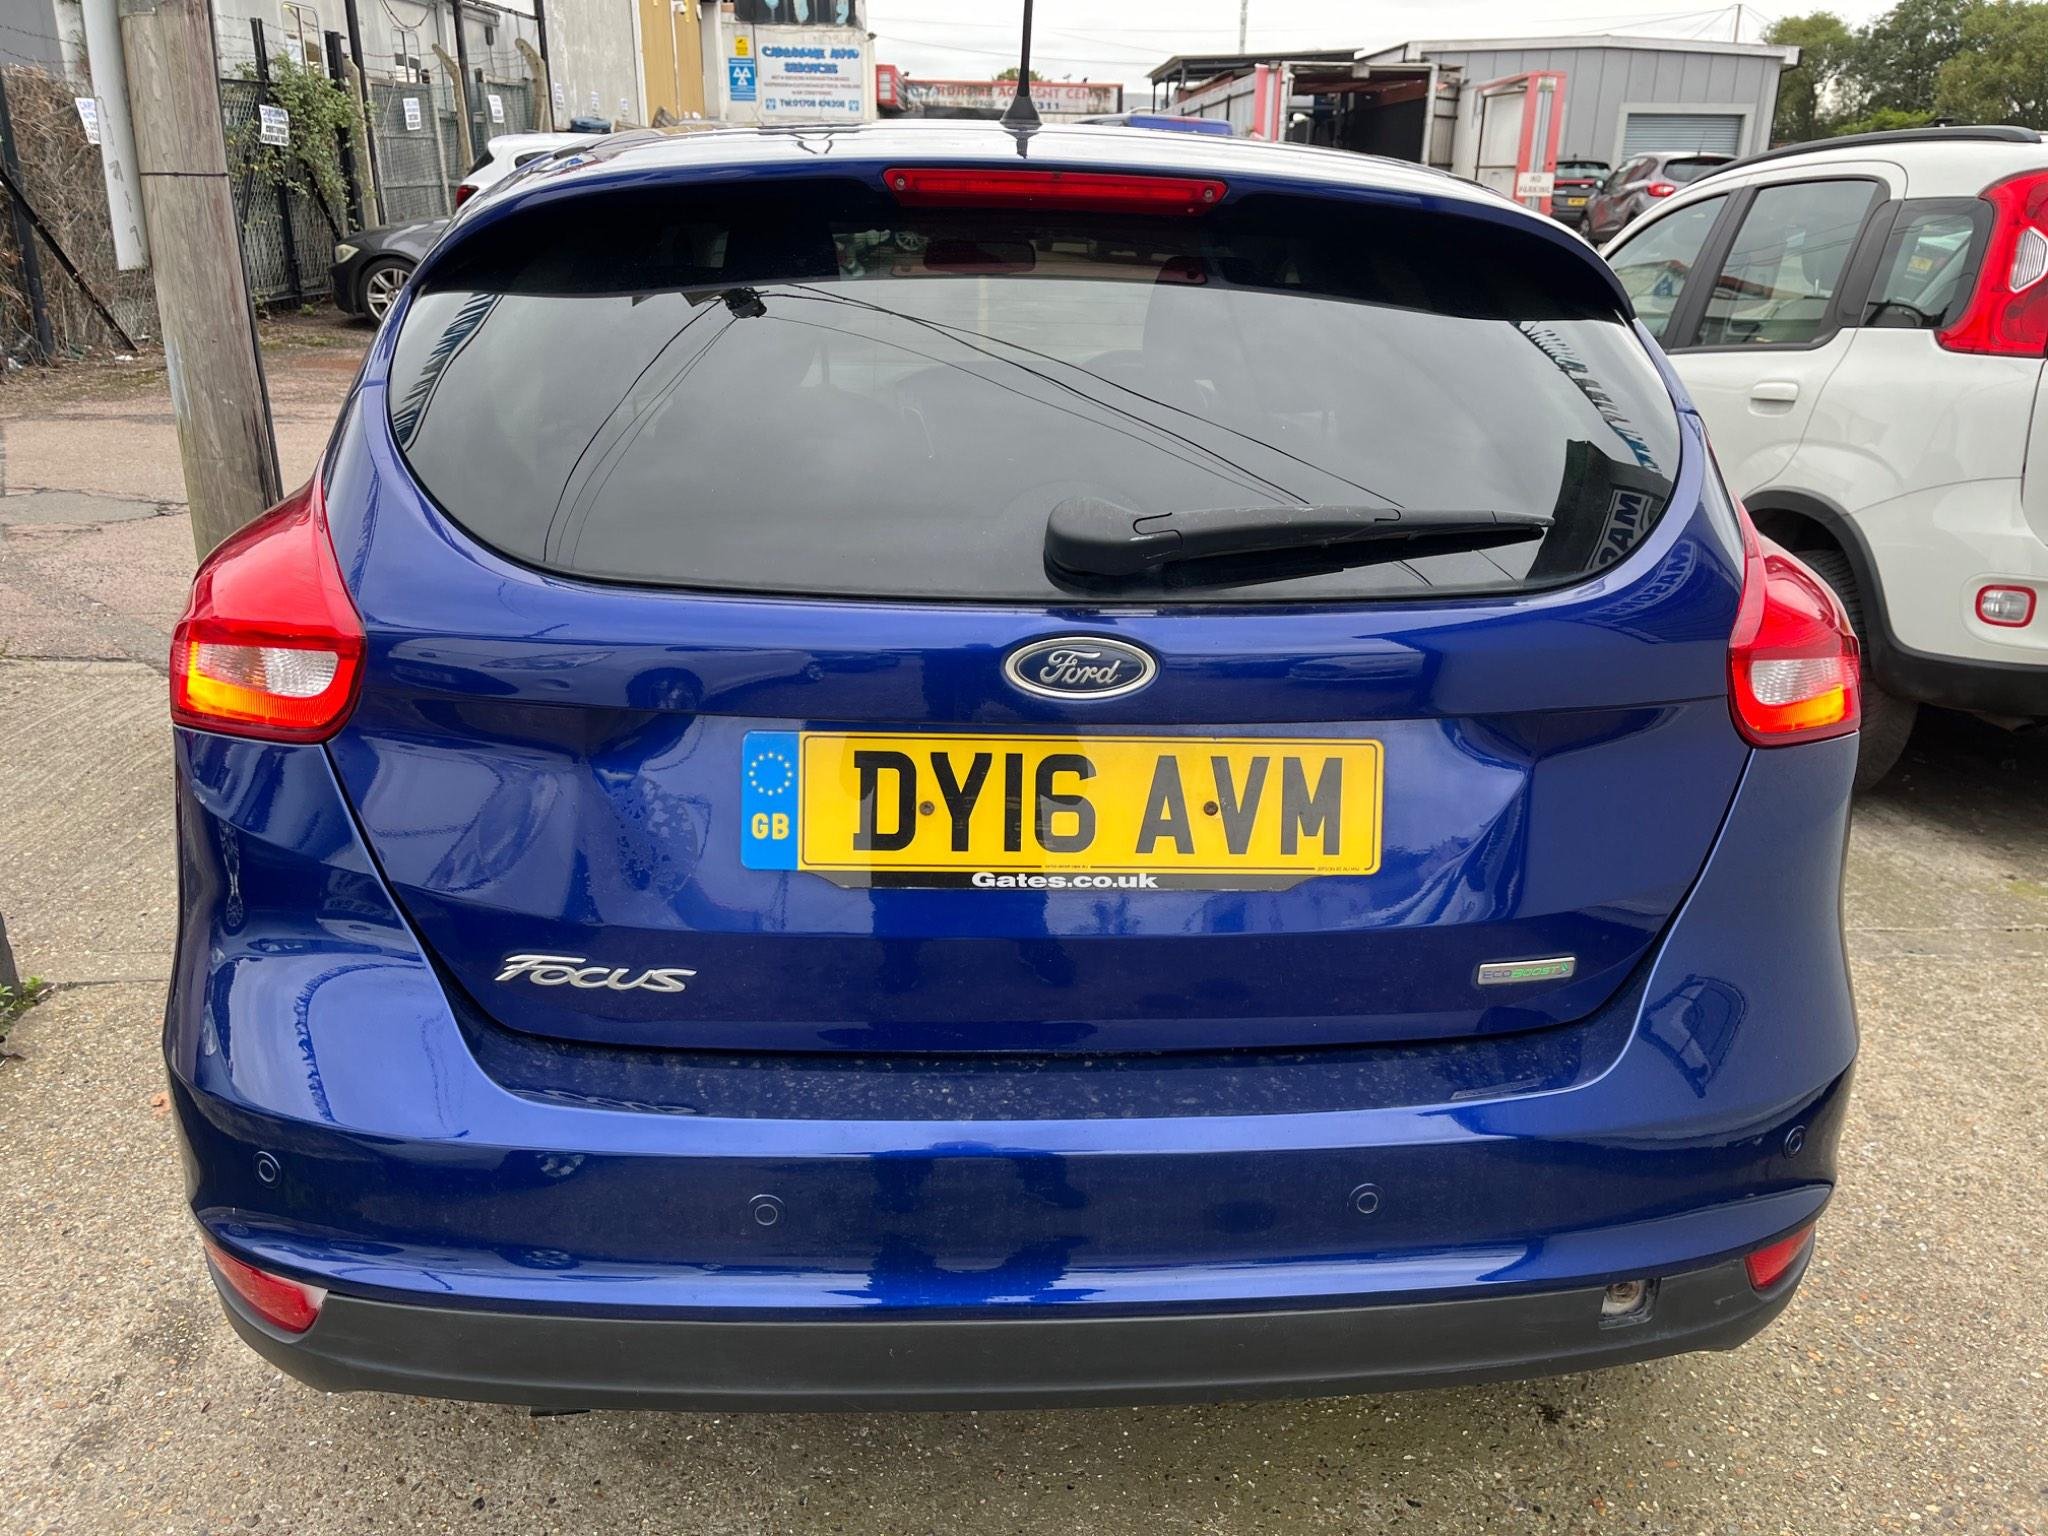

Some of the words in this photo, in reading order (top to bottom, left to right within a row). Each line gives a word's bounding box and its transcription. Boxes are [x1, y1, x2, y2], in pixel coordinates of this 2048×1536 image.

[1040, 650, 1112, 684] Ford
[853, 750, 1096, 853] DY16
[1134, 754, 1343, 856] AVM
[751, 812, 789, 840] GB
[971, 871, 1159, 889] Gates.co.uk
